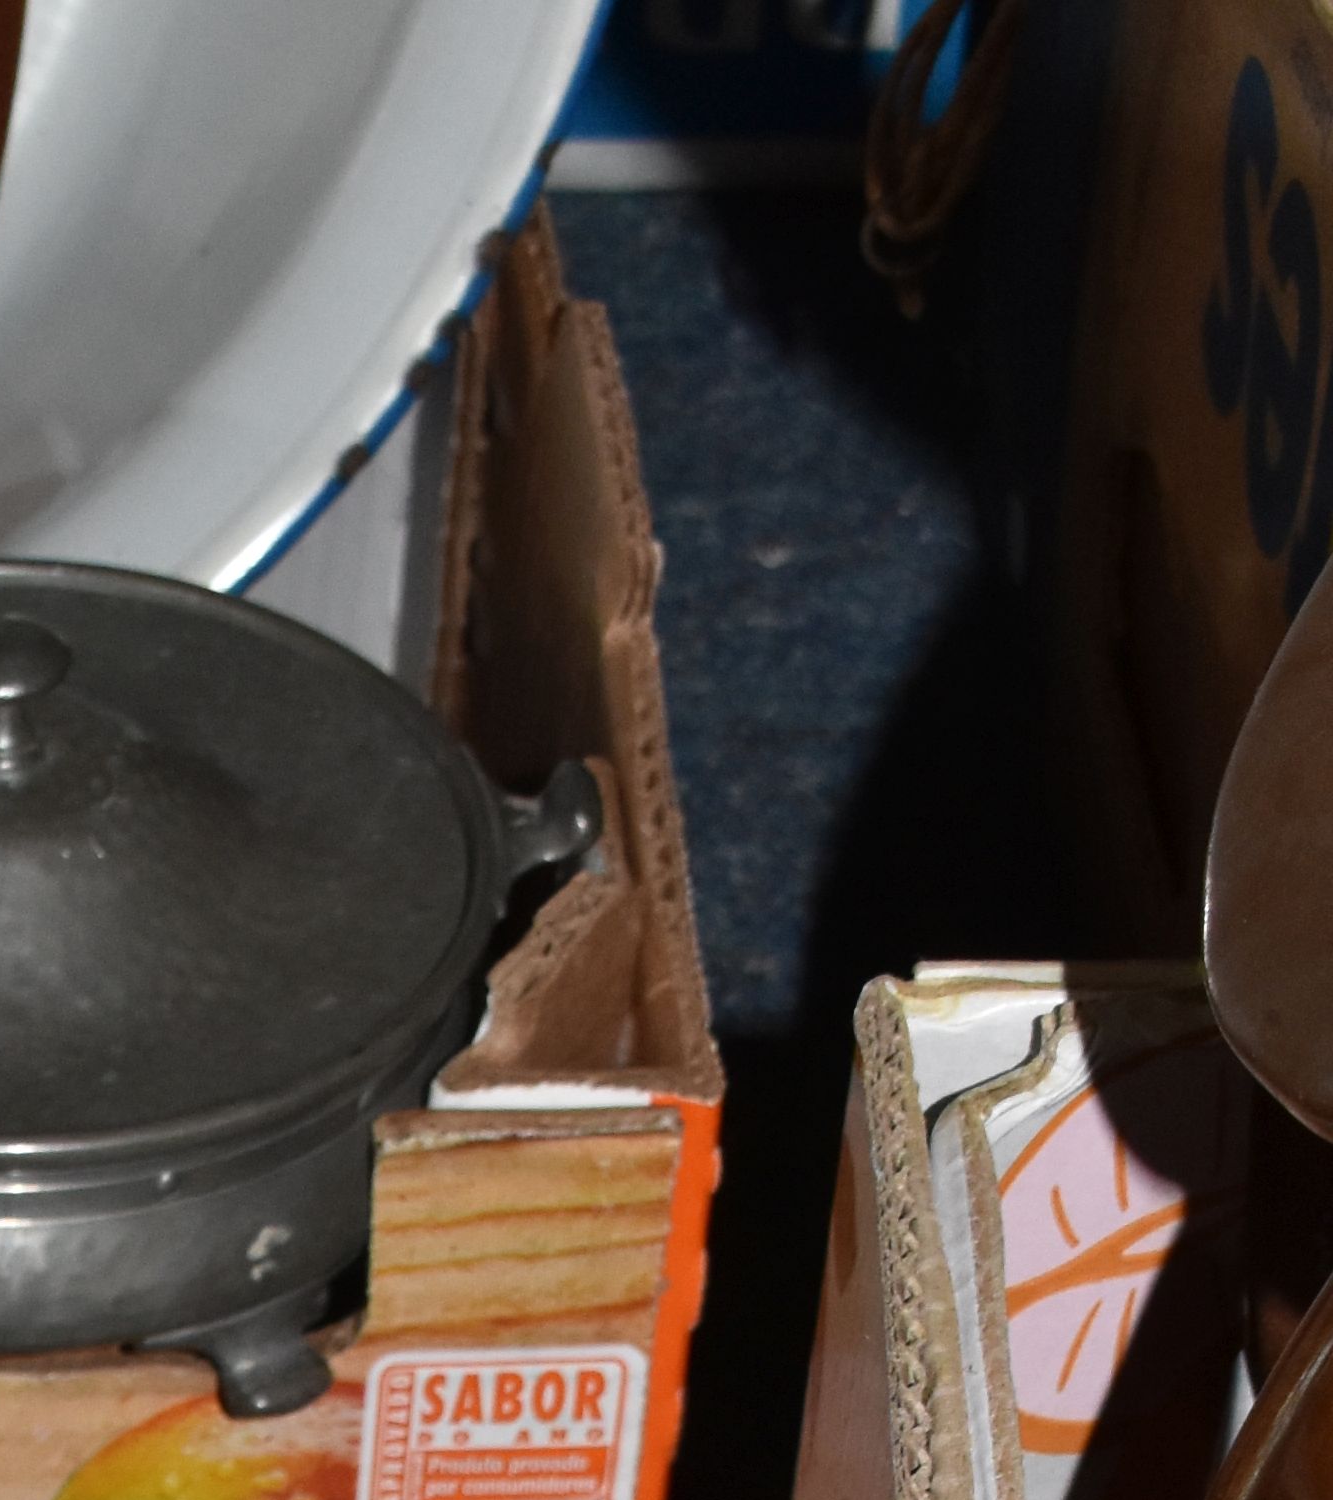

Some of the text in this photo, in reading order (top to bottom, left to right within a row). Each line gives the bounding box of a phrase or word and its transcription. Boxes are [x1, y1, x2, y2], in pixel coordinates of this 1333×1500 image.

[421, 1370, 607, 1424] SABOR
[426, 1457, 503, 1476] Produto
[424, 1479, 458, 1499] por
